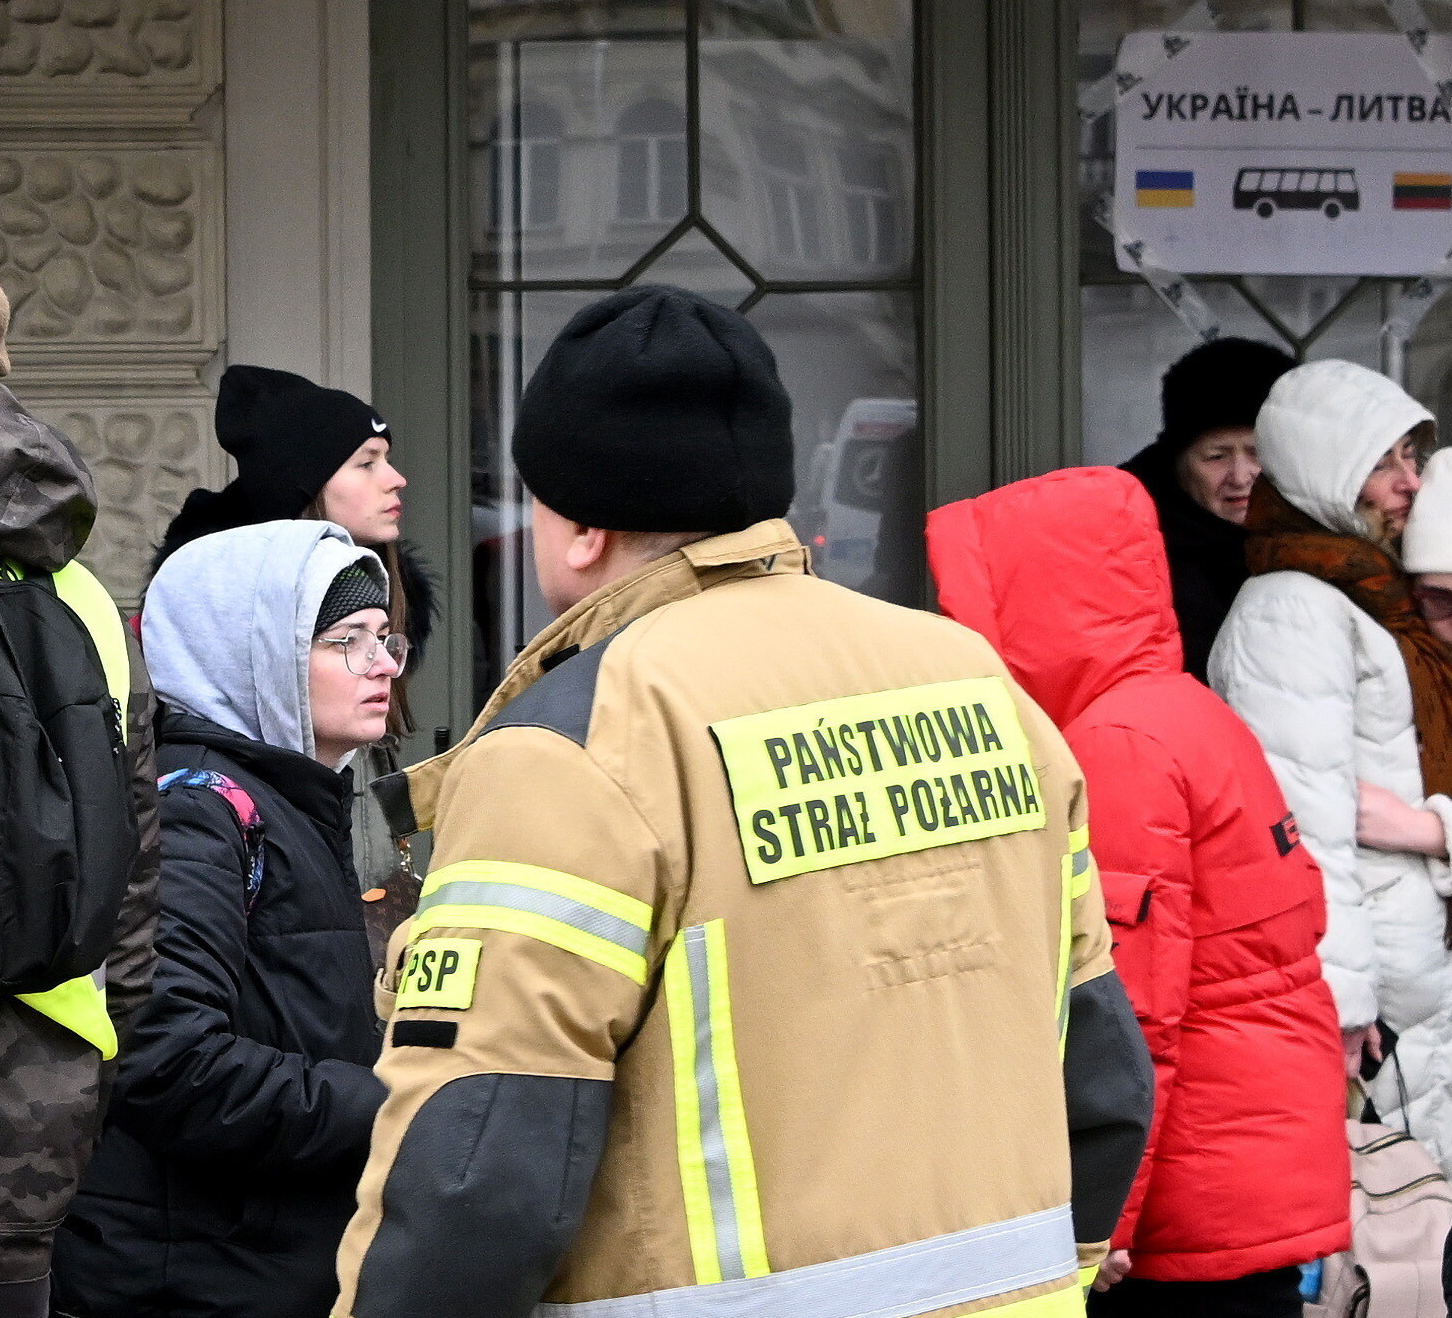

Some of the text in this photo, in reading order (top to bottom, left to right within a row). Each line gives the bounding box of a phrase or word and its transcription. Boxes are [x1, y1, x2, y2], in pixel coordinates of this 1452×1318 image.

[1141, 87, 1300, 122] УКРАЇНА
[1329, 93, 1452, 123] ЛИТВА
[763, 702, 1004, 790] PAŃSTWOWA
[752, 763, 1040, 865] STRAŻ POŻARNA
